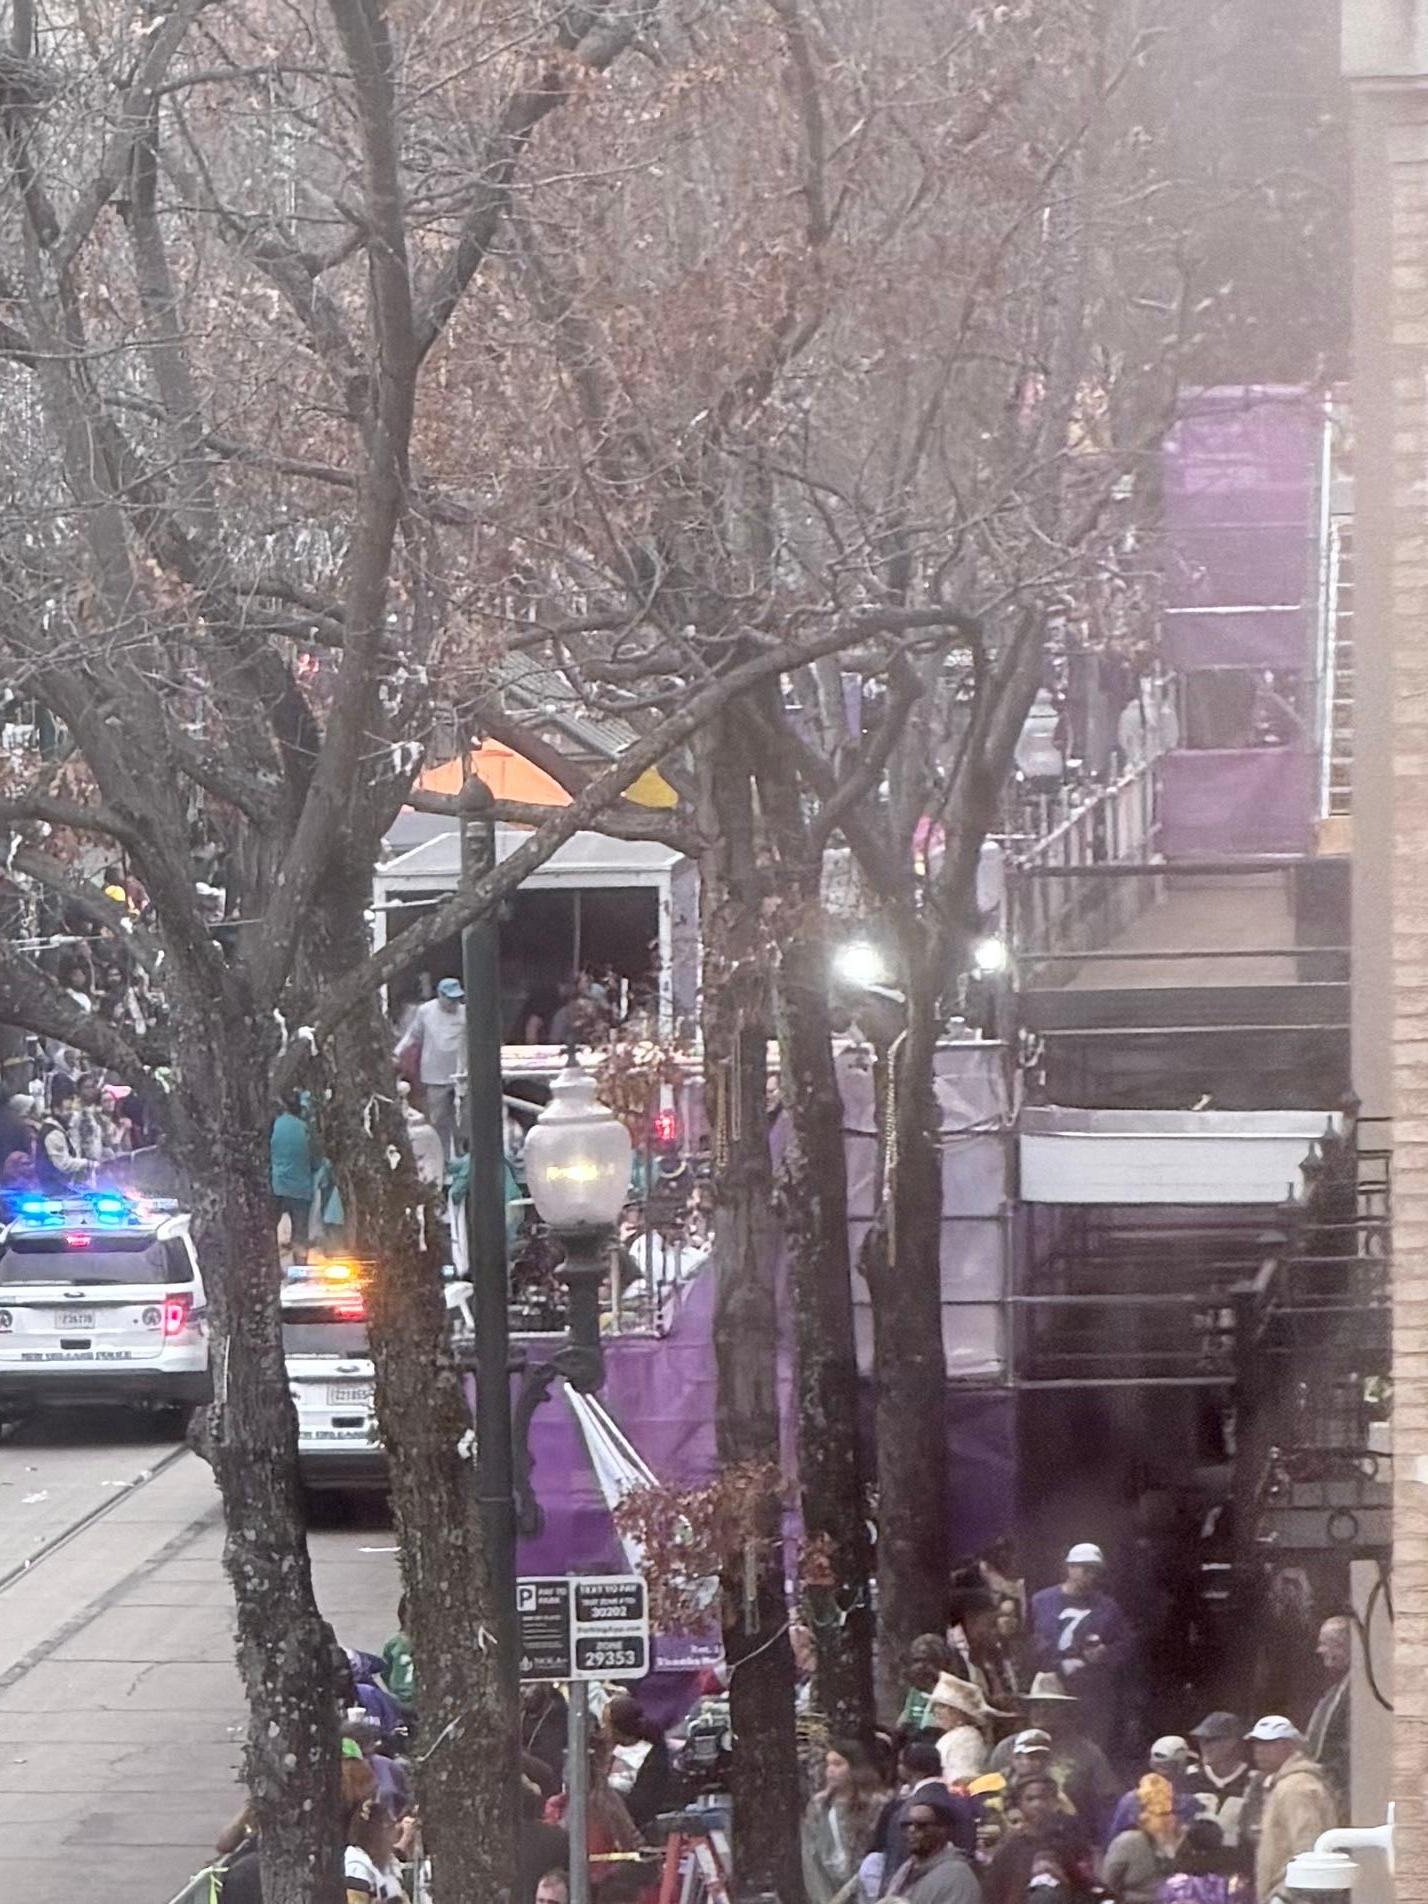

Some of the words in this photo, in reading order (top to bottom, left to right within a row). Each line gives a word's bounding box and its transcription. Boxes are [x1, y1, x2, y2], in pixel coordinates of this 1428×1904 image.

[590, 1606, 627, 1618] 30202
[1057, 1607, 1092, 1651] 7
[585, 1650, 636, 1667] 29353
